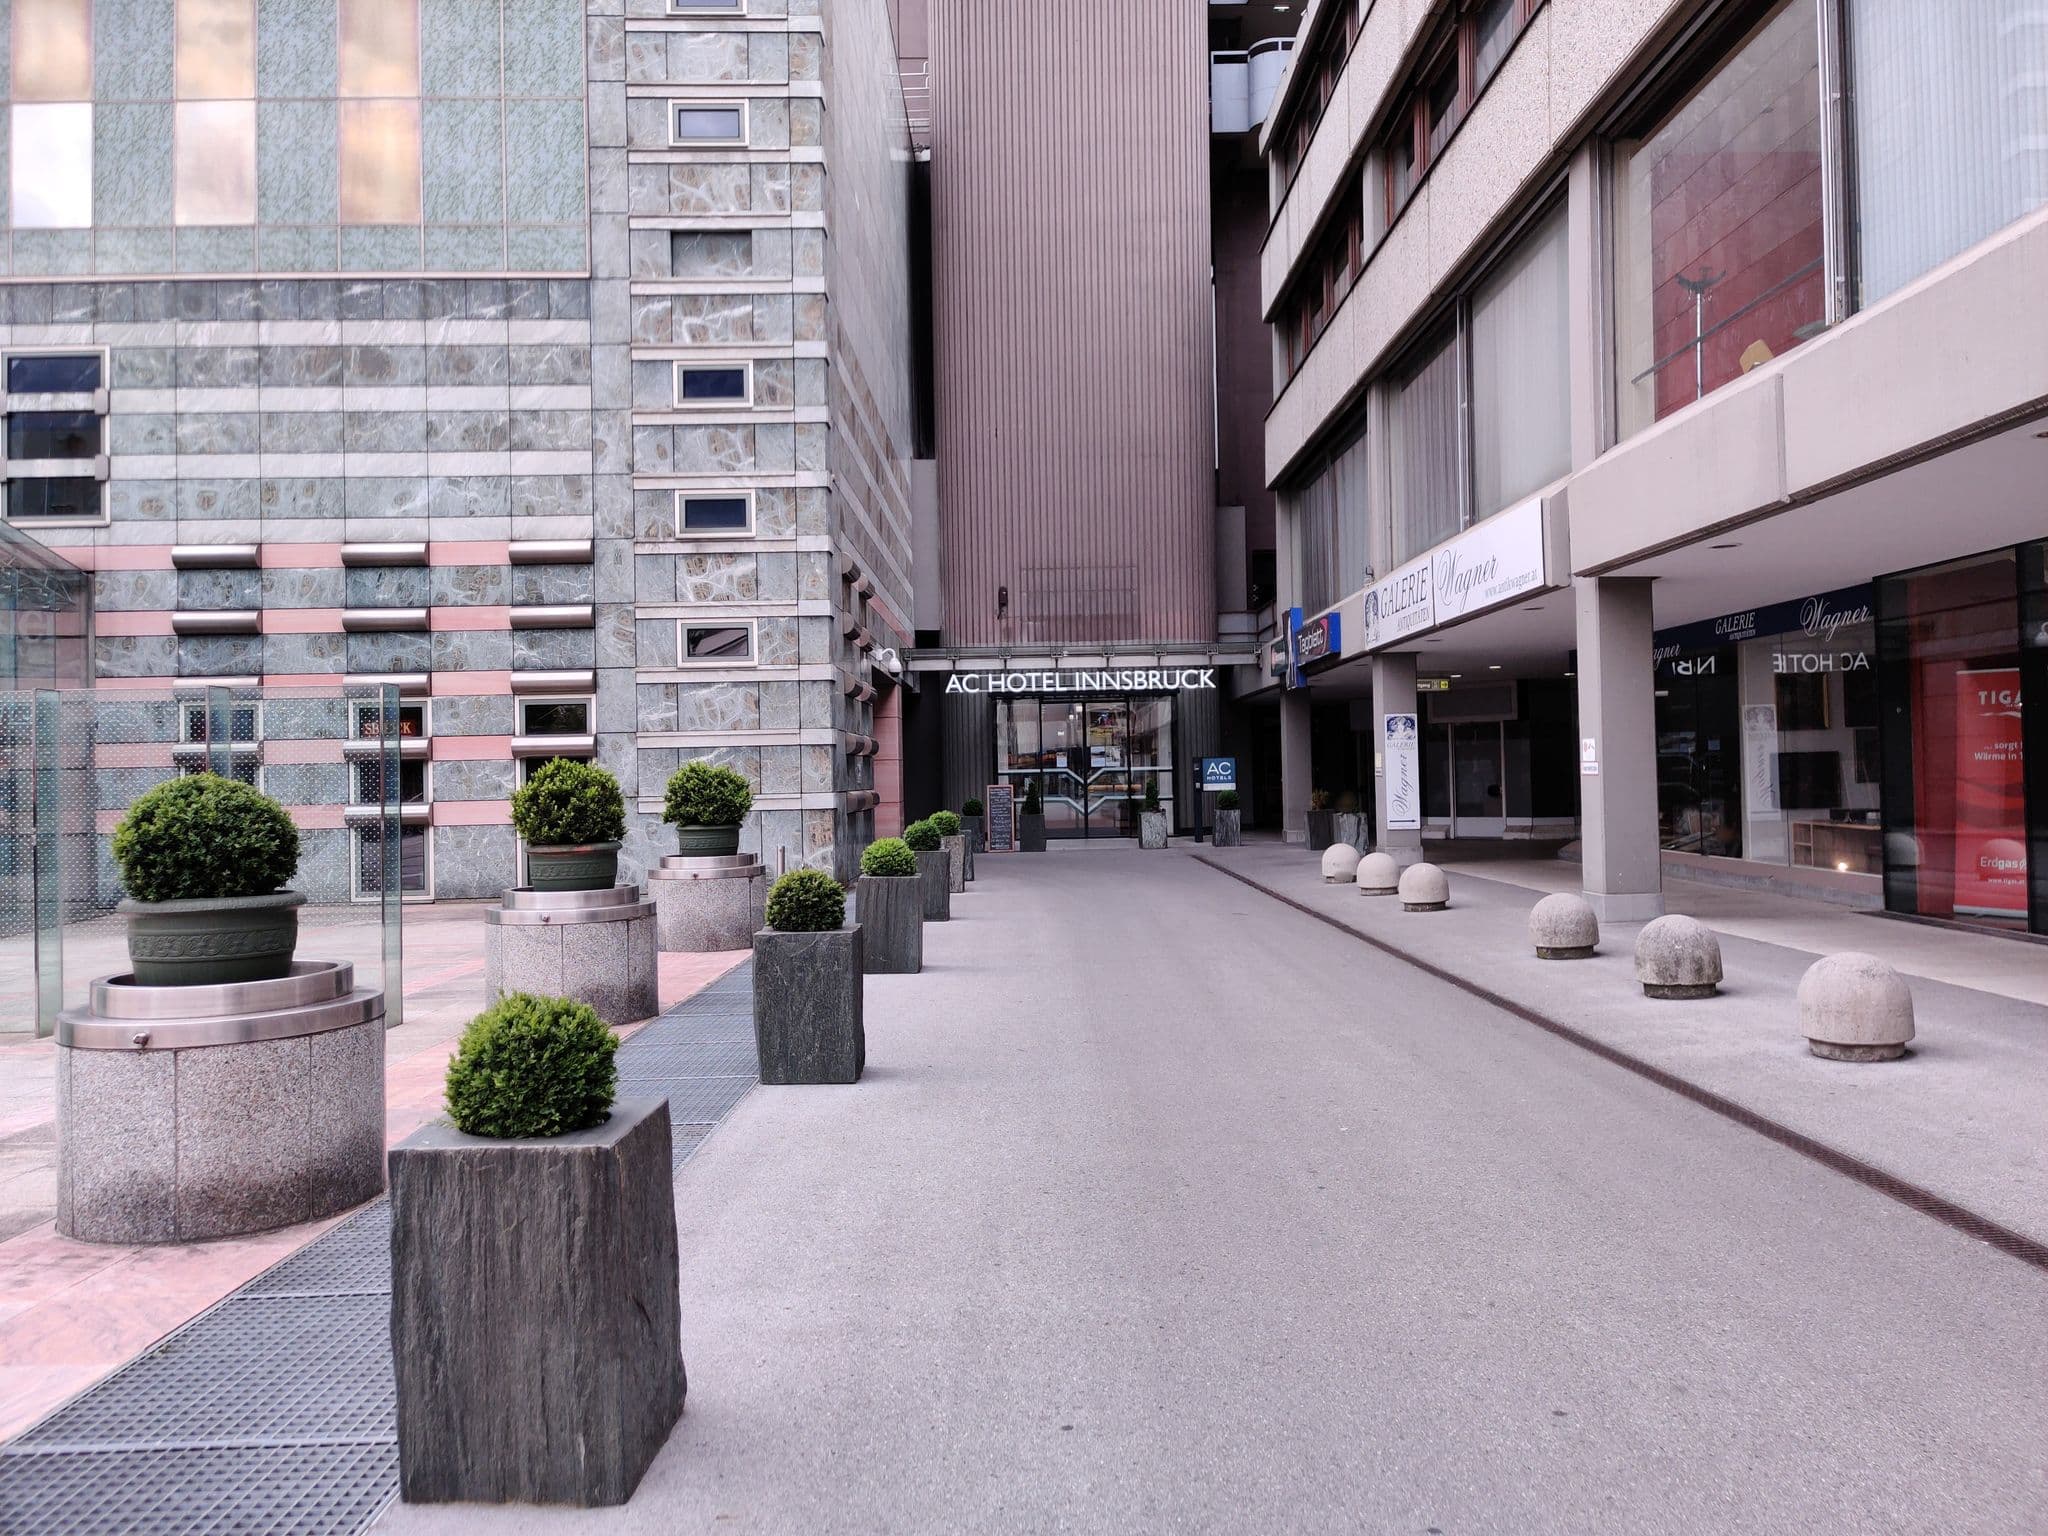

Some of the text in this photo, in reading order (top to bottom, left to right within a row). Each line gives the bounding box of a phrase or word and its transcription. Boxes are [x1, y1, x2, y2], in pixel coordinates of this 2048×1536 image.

[1381, 566, 1428, 619] GALERIE
[1437, 548, 1498, 613] Wagner
[1715, 611, 1756, 635] GALERIE
[1800, 597, 1871, 642] Wagner
[1298, 623, 1325, 655] Tagblatt
[945, 668, 1216, 693] AC HOTEL INNSBRUCK
[1994, 742, 2017, 751] sorgt
[1206, 762, 1232, 775] AC
[1392, 752, 1414, 817] Wagner
[1980, 856, 2018, 870] Erdgas
